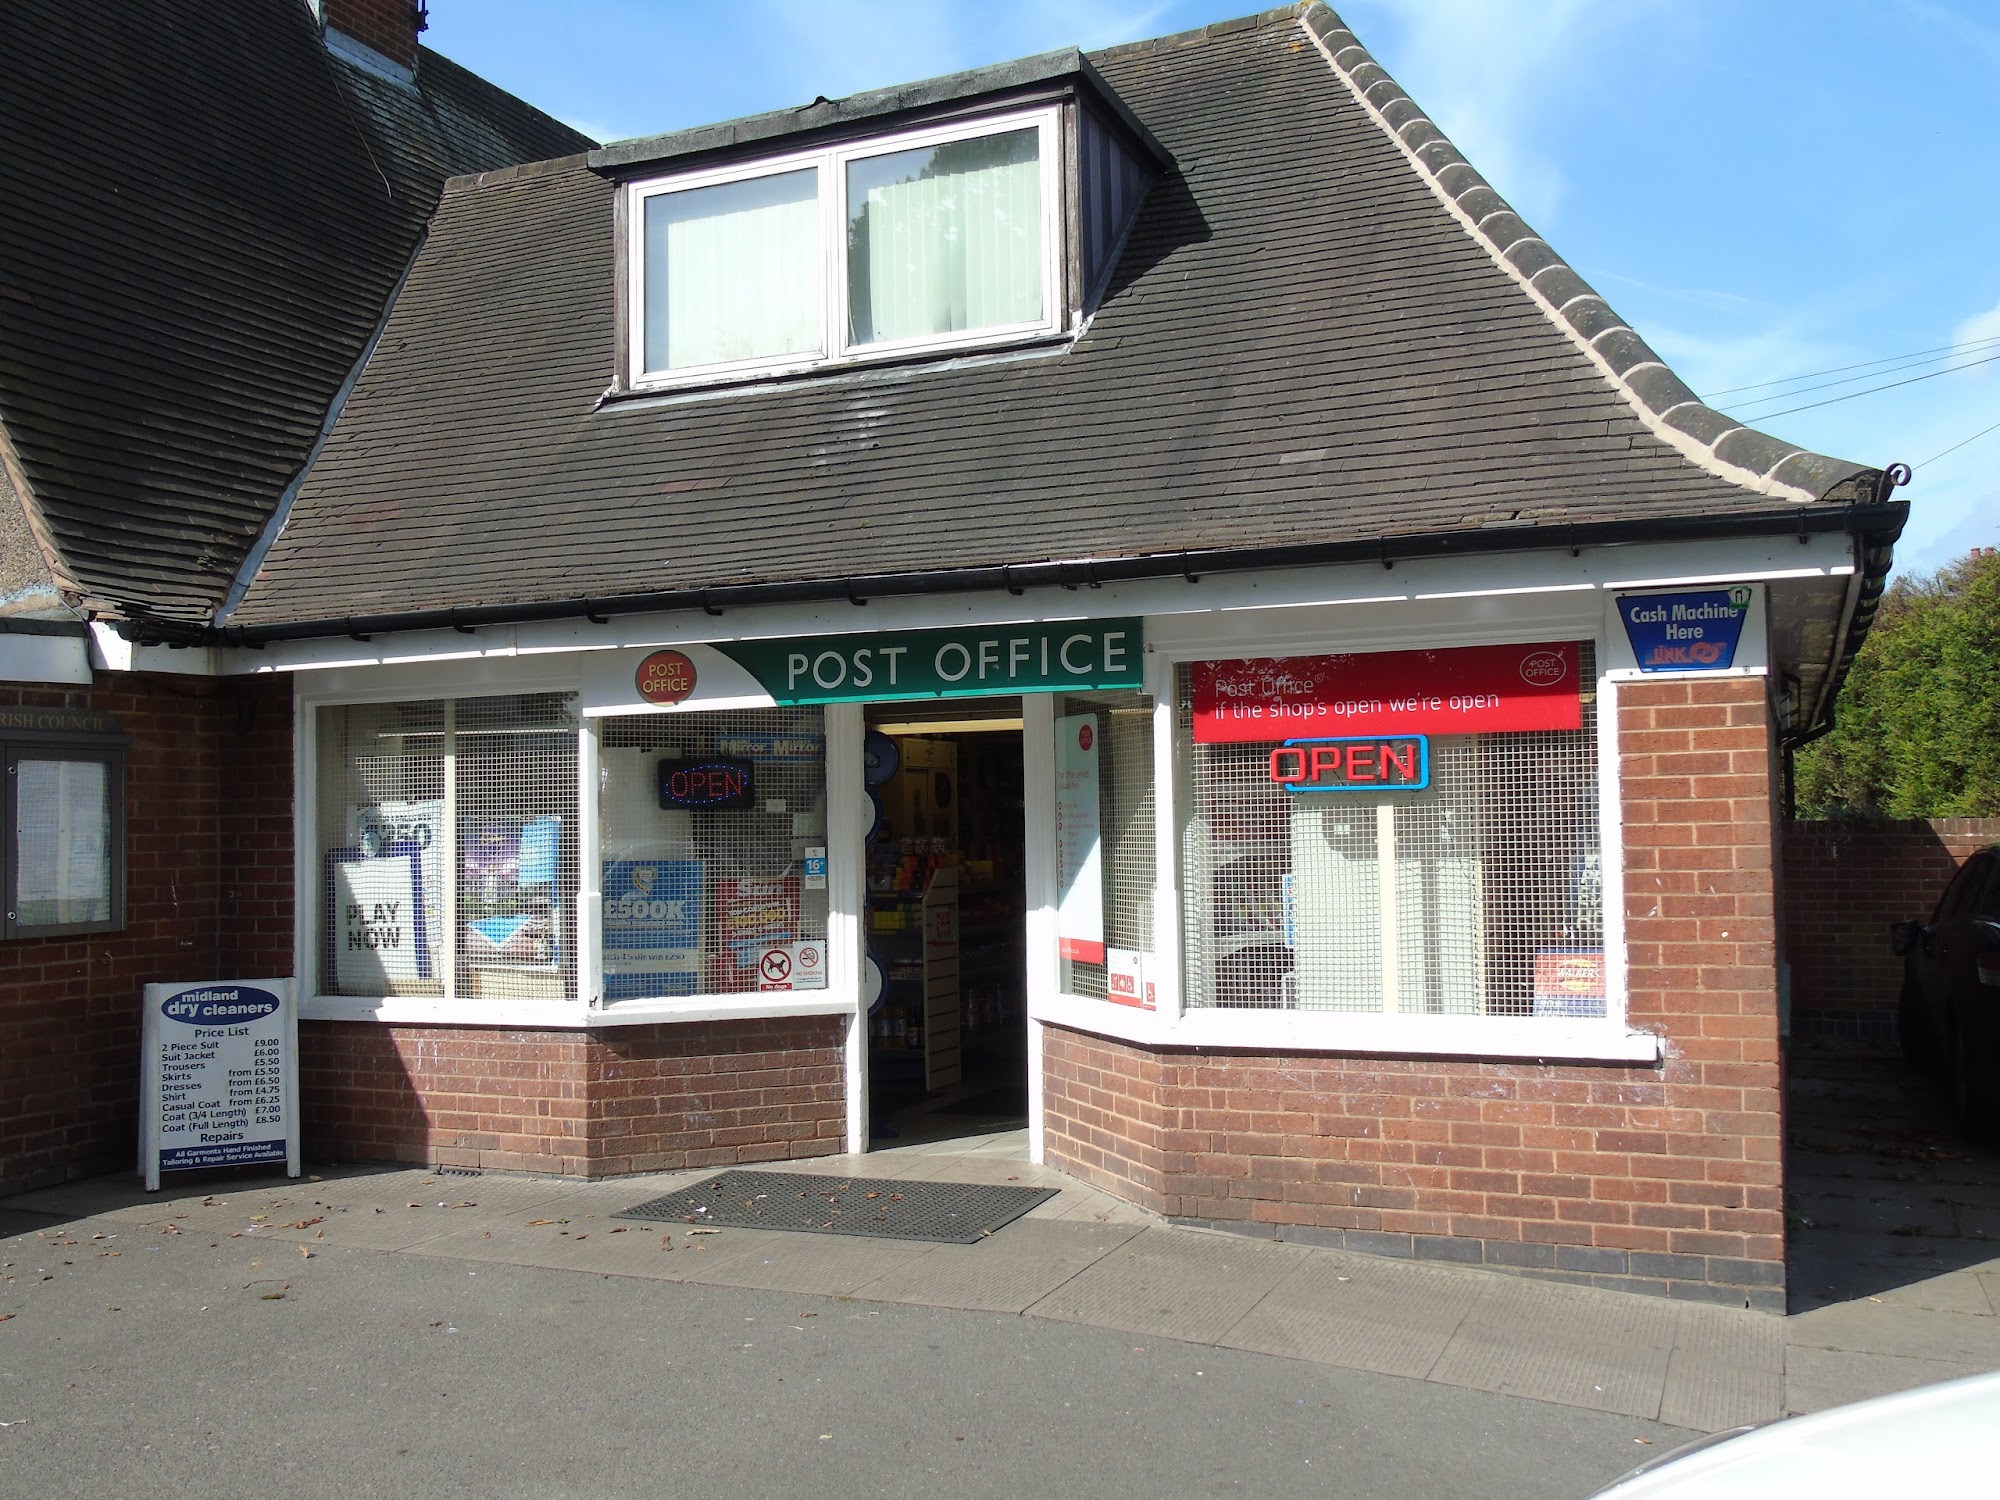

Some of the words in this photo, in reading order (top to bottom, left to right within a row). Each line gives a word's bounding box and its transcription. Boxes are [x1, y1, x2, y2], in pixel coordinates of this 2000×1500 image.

[1630, 604, 1667, 623] Cash
[1672, 602, 1738, 621] Machine
[1666, 624, 1704, 640] Here
[788, 647, 908, 691] POST
[934, 632, 1127, 682] OFFICE
[1531, 658, 1556, 668] POST
[649, 662, 683, 678] POST
[1525, 667, 1560, 678] OFFICE
[642, 678, 688, 693] OFFICE
[1216, 680, 1255, 698] Post
[1216, 702, 1225, 720] if
[1234, 700, 1262, 719] the
[1269, 697, 1327, 720] shop's
[1334, 699, 1382, 718] open
[1389, 692, 1442, 713] we're
[1449, 693, 1500, 714] open
[38, 714, 104, 731] COUNCIL
[1270, 745, 1416, 782] OPEN
[671, 772, 742, 797] OPEN
[806, 860, 824, 870] 16+
[346, 902, 400, 926] PLAY
[604, 900, 686, 920] £500K
[348, 927, 400, 950] NOW
[182, 990, 238, 1002] midland
[168, 1001, 199, 1017] dry
[202, 1003, 273, 1016] cleaners
[194, 1029, 224, 1038] Price
[228, 1027, 250, 1036] List
[171, 1043, 198, 1051] Piece
[254, 1039, 280, 1047] £9.00
[162, 1053, 181, 1062] Suit
[184, 1051, 216, 1060] Jacket
[254, 1049, 280, 1057] £6.00
[162, 1063, 206, 1071] Trousers
[254, 1058, 280, 1066] £5.50
[162, 1073, 192, 1082] Skirts
[255, 1068, 280, 1076] £5.50
[162, 1082, 202, 1092] Dresses
[228, 1079, 252, 1087] from
[255, 1077, 280, 1085] £6.50
[162, 1093, 186, 1101] Shirt
[229, 1089, 252, 1097] from
[255, 1086, 280, 1095] £4.75
[162, 1102, 195, 1112] Casual
[198, 1100, 221, 1109] Coat
[255, 1096, 280, 1105] £6.25
[162, 1113, 185, 1122] Coat
[189, 1111, 207, 1121] (3/4
[210, 1108, 247, 1118] Length)
[255, 1106, 280, 1114] £7.00
[162, 1124, 185, 1132] Coat
[189, 1122, 209, 1132] (Full
[212, 1119, 249, 1129] Length)
[256, 1115, 280, 1124] £8.50
[200, 1131, 244, 1143] Repairs
[187, 1148, 222, 1156] Garments
[243, 1144, 271, 1152] Finished
[162, 1158, 193, 1166] Tailoring
